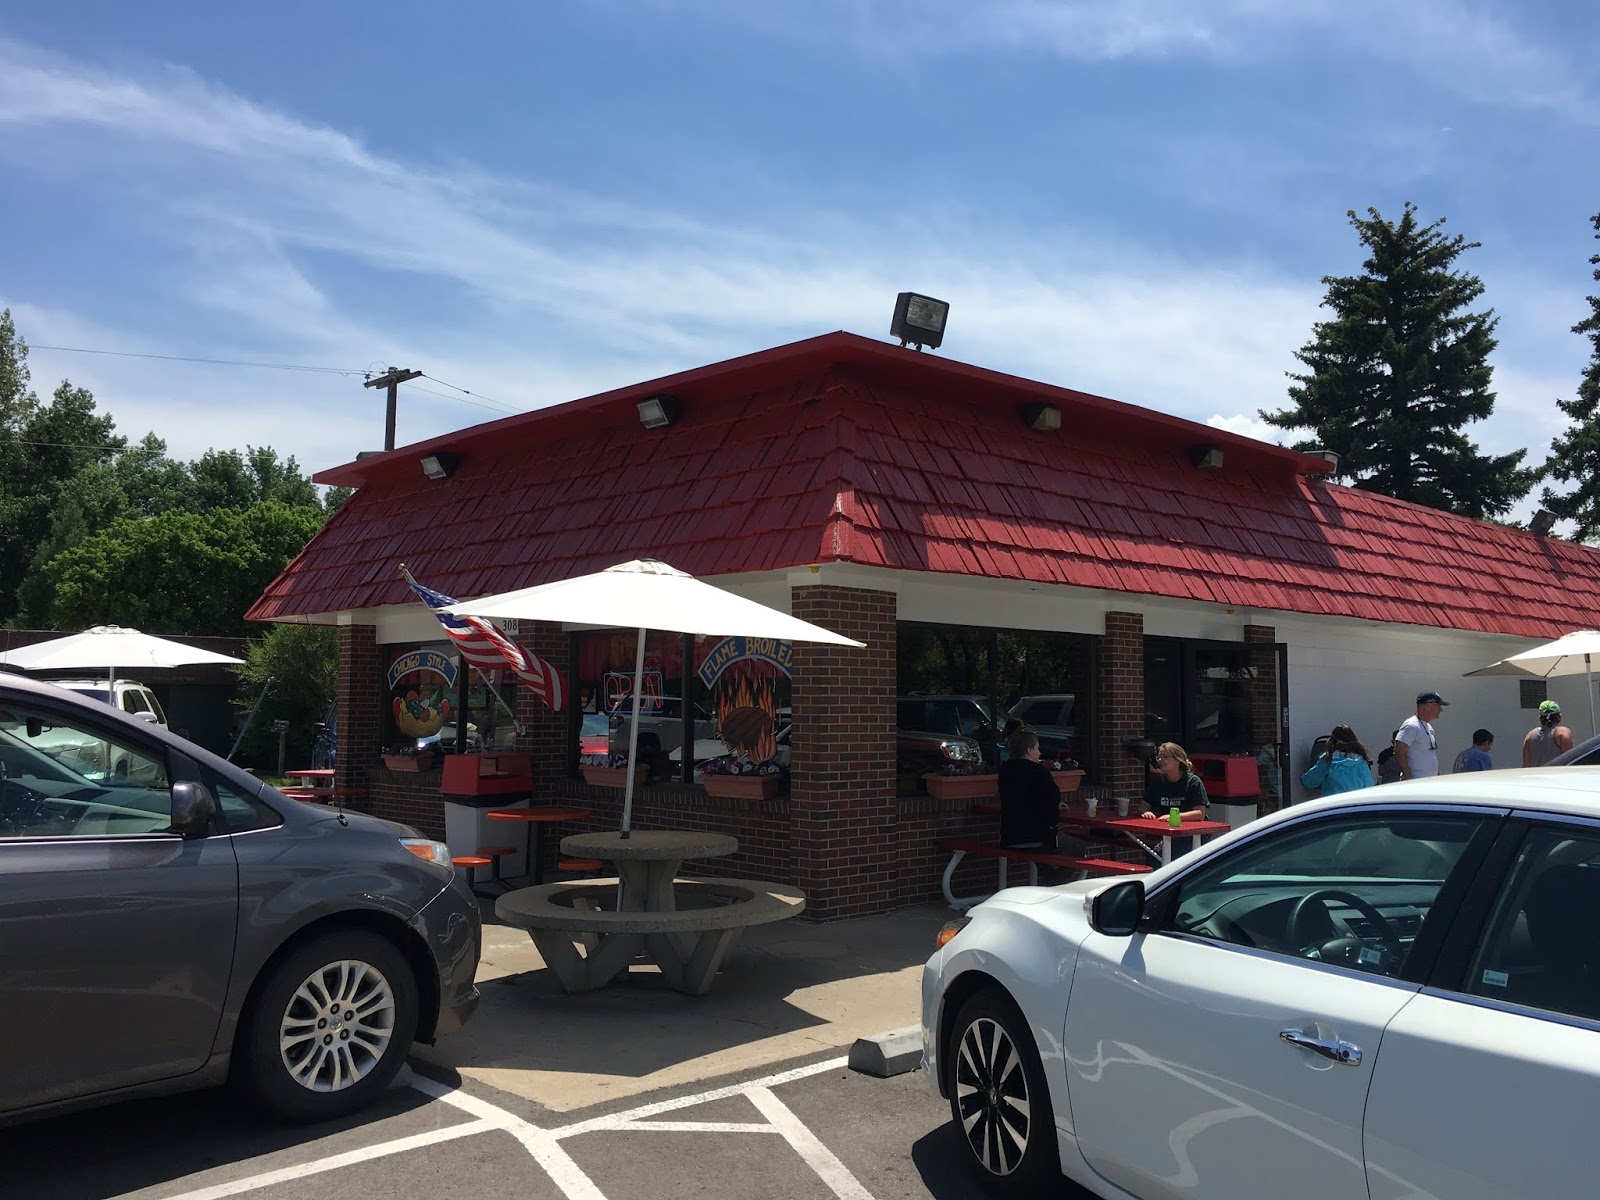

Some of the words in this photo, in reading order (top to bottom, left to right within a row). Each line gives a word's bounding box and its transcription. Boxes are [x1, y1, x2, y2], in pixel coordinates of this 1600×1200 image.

[503, 619, 517, 631] 308
[394, 654, 420, 677] CHICAGO
[427, 654, 447, 672] STYLE
[703, 641, 738, 679] FLAME
